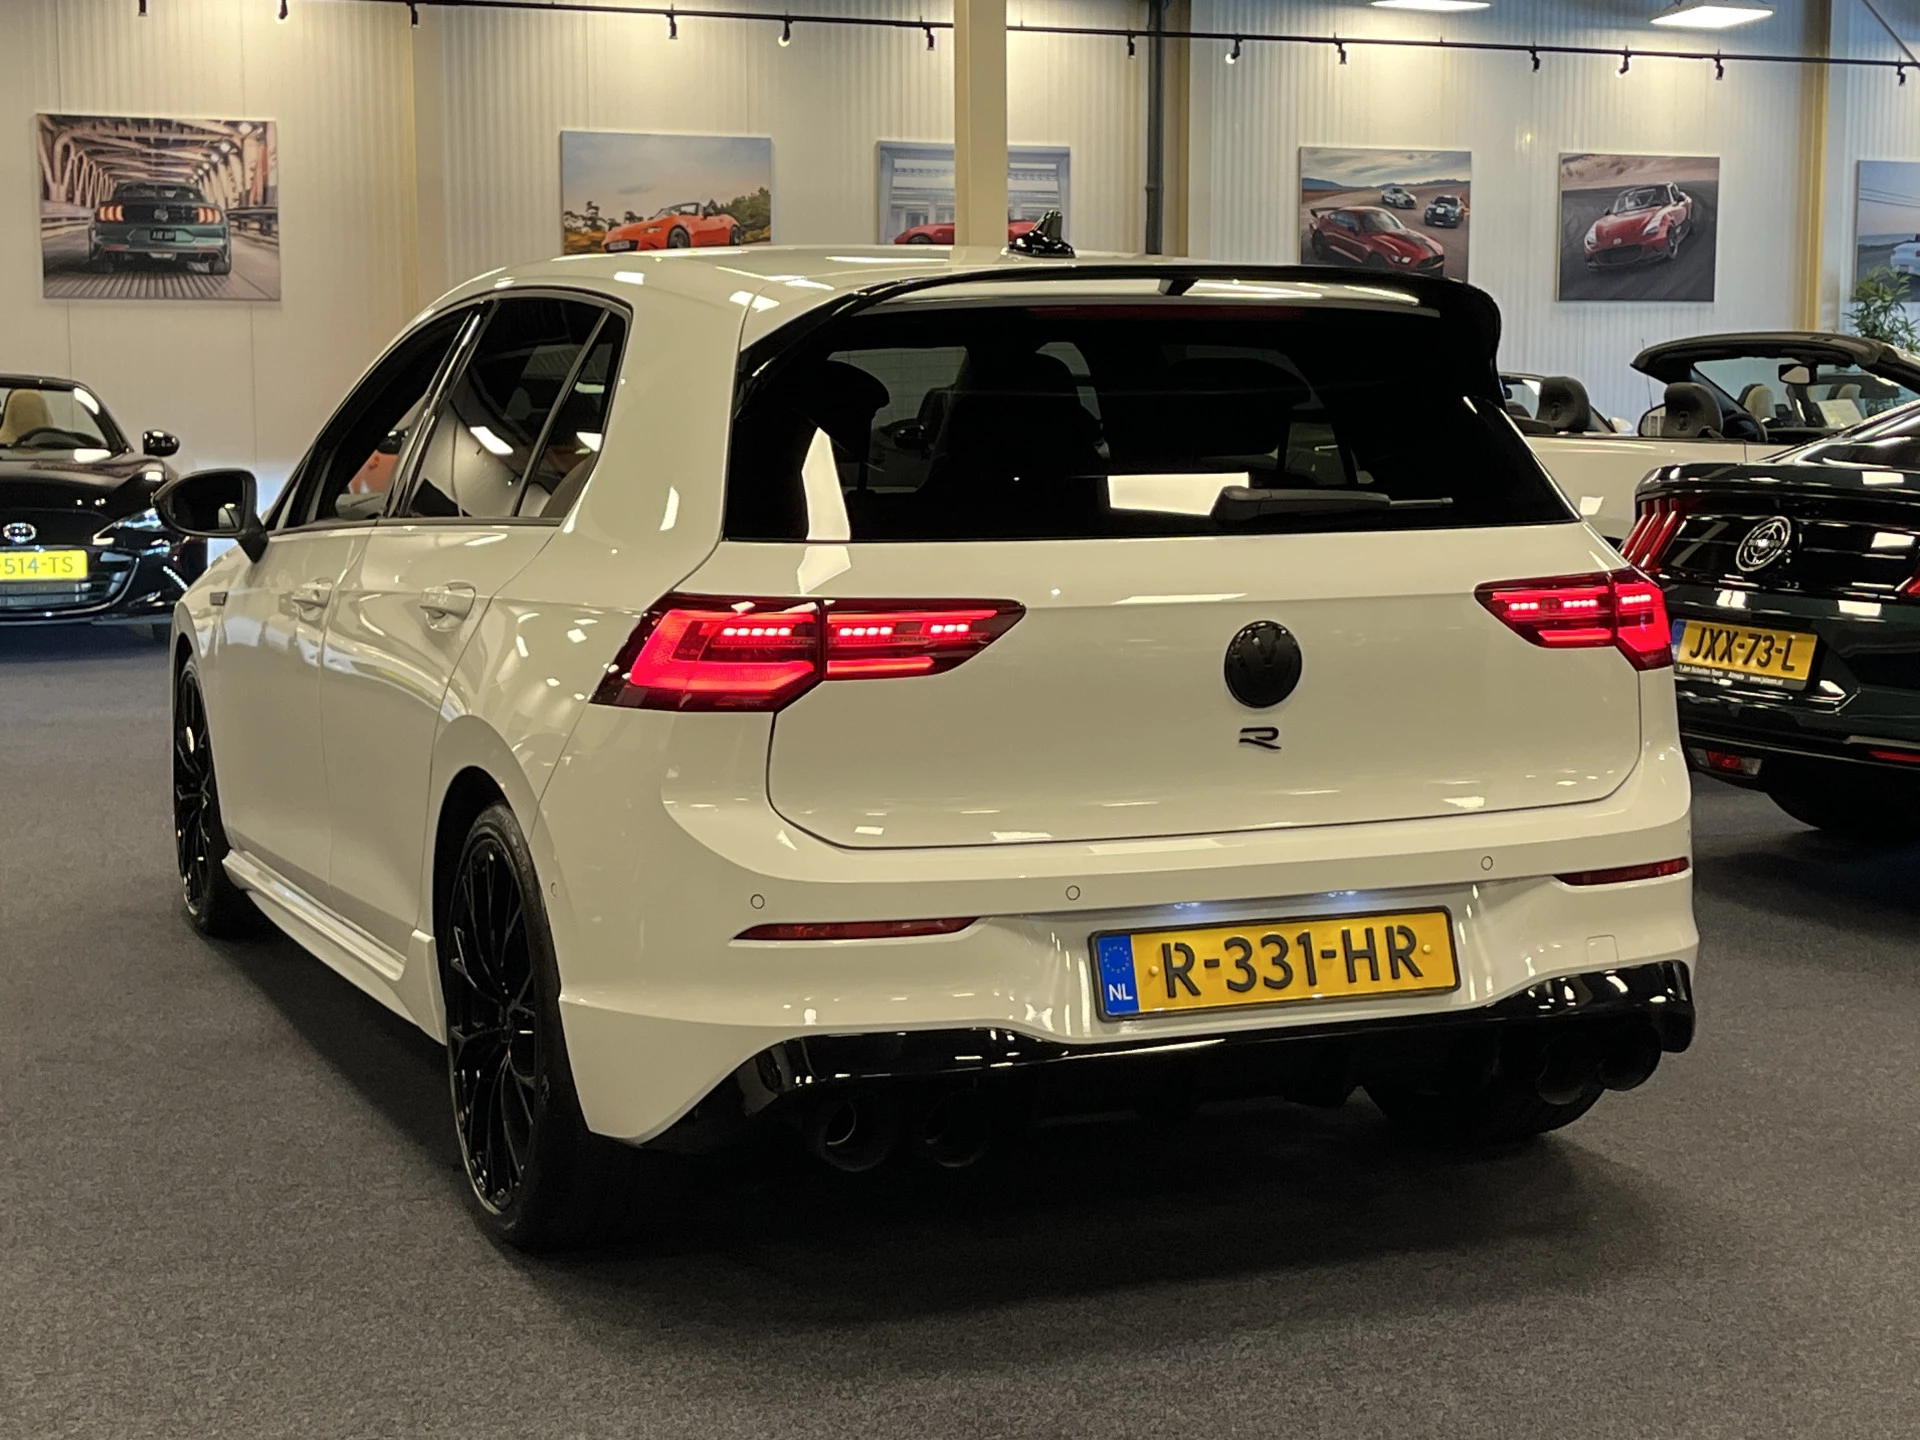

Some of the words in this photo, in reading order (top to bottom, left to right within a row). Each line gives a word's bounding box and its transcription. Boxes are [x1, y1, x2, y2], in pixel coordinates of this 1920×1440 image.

[0, 556, 74, 575] 514-TS
[1690, 627, 1796, 672] JXX-73-L
[1239, 726, 1282, 750] R
[1108, 983, 1134, 1001] NL
[1161, 924, 1424, 999] R-331-HR
